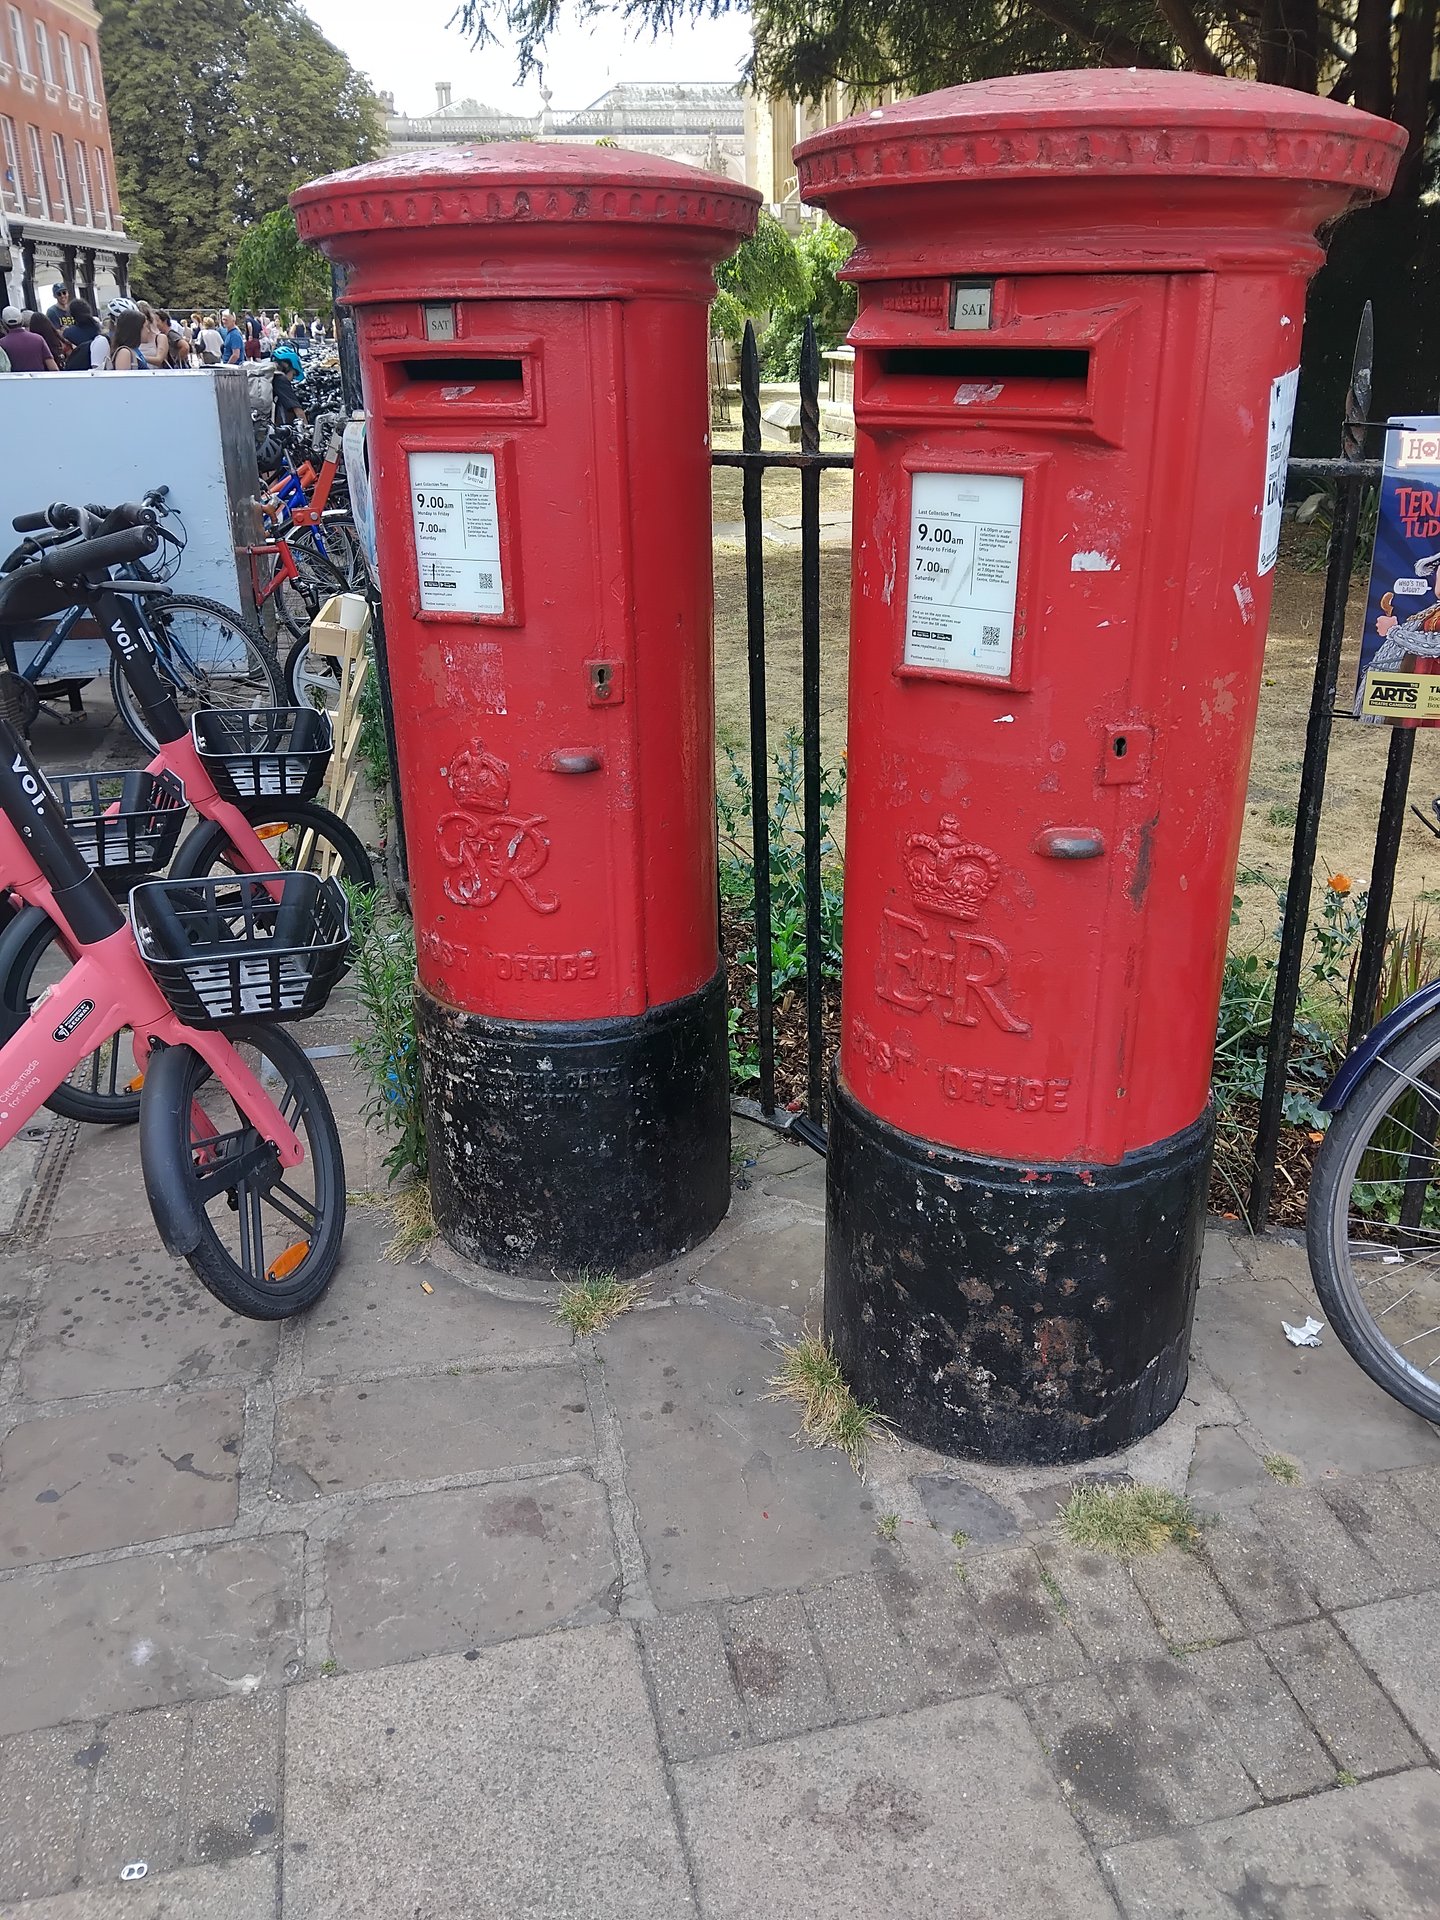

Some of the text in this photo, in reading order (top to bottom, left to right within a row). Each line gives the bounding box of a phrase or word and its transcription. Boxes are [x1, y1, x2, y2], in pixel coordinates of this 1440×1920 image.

[962, 304, 986, 316] SAT
[432, 320, 450, 330] SAT
[417, 493, 454, 508] 9.00am
[418, 522, 446, 533] 7.00am
[918, 524, 964, 544] 9.00am
[916, 558, 950, 574] 7.00am
[111, 618, 139, 661] voi.
[1370, 687, 1418, 702] ARTS
[11, 754, 48, 816] voi.
[496, 950, 600, 982] OFFICE
[68, 1005, 90, 1030] SEGWAY
[852, 1015, 914, 1083] POST
[0, 1059, 40, 1103] Cities made
[942, 1065, 1070, 1113] OFFICE
[8, 1097, 21, 1108] for
